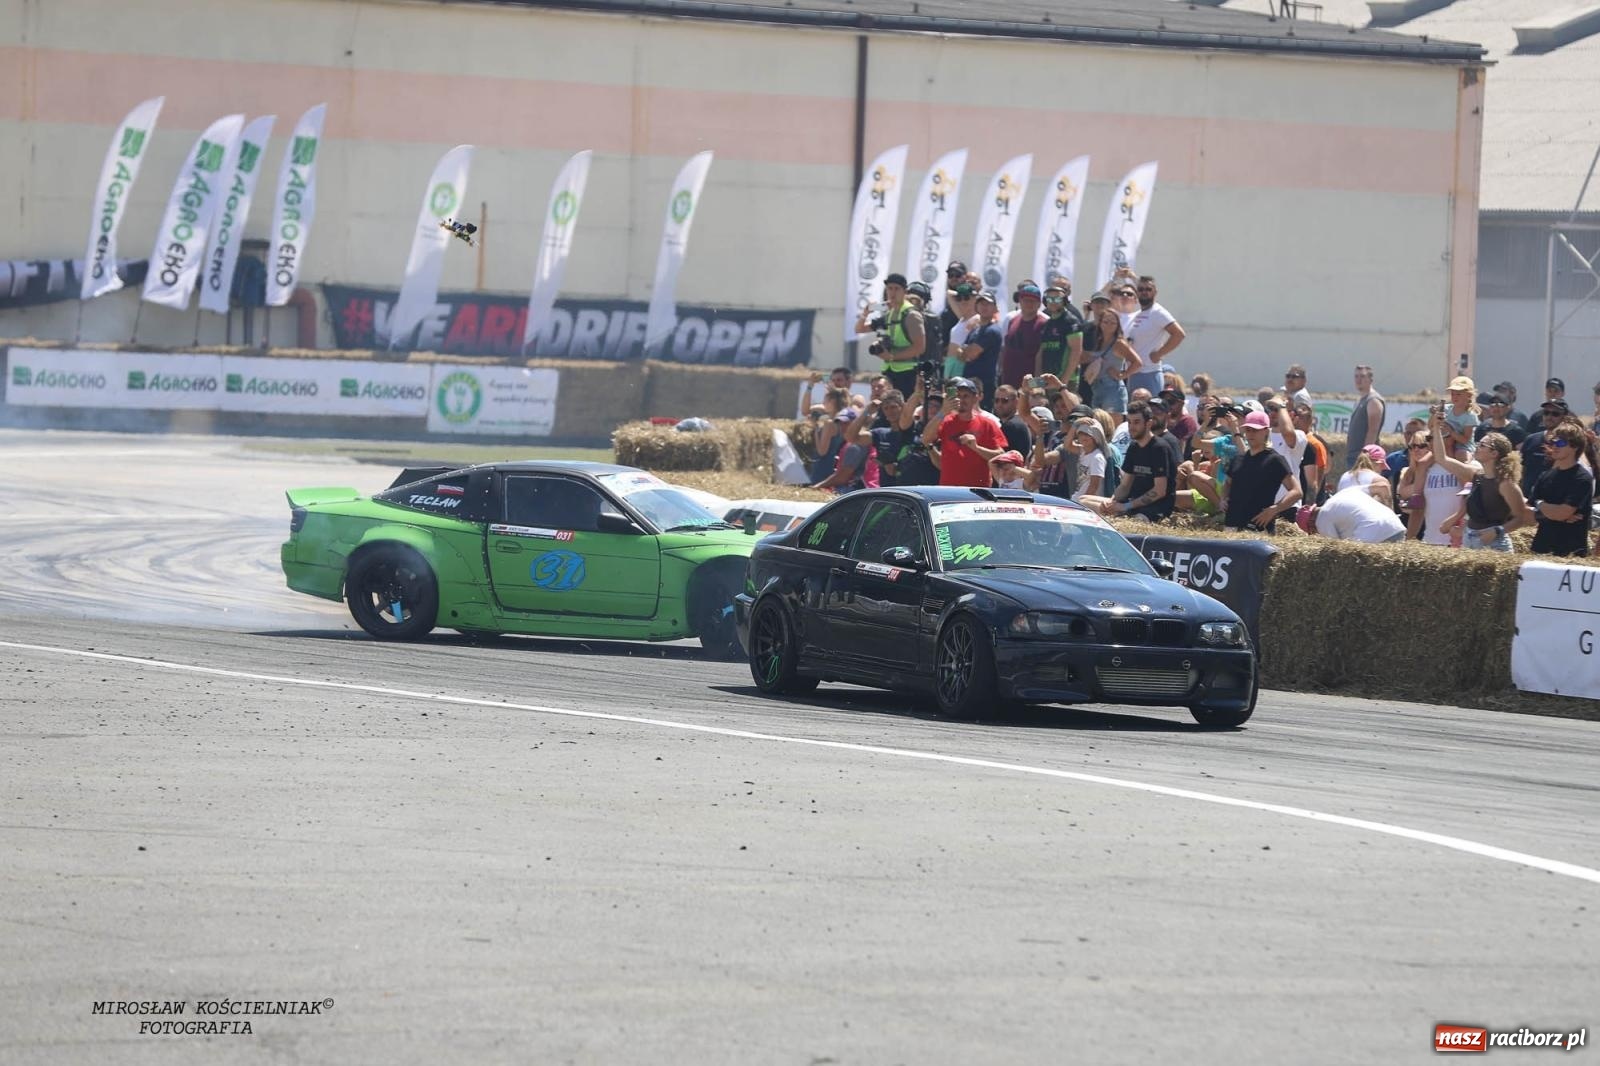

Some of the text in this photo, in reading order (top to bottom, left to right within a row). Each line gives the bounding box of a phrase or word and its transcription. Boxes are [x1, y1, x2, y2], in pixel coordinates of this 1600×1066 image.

[92, 161, 132, 280] AGROEKO
[160, 171, 211, 287] AGROEKO
[209, 173, 246, 292] AGROEKO
[275, 169, 306, 287] AGROEKO
[34, 368, 107, 390] AGROEKO
[149, 372, 217, 392] AGROEKO
[244, 374, 318, 396] AGROEKO
[360, 381, 425, 400] AGROEKO
[556, 531, 572, 541] 031
[536, 553, 581, 590] 31
